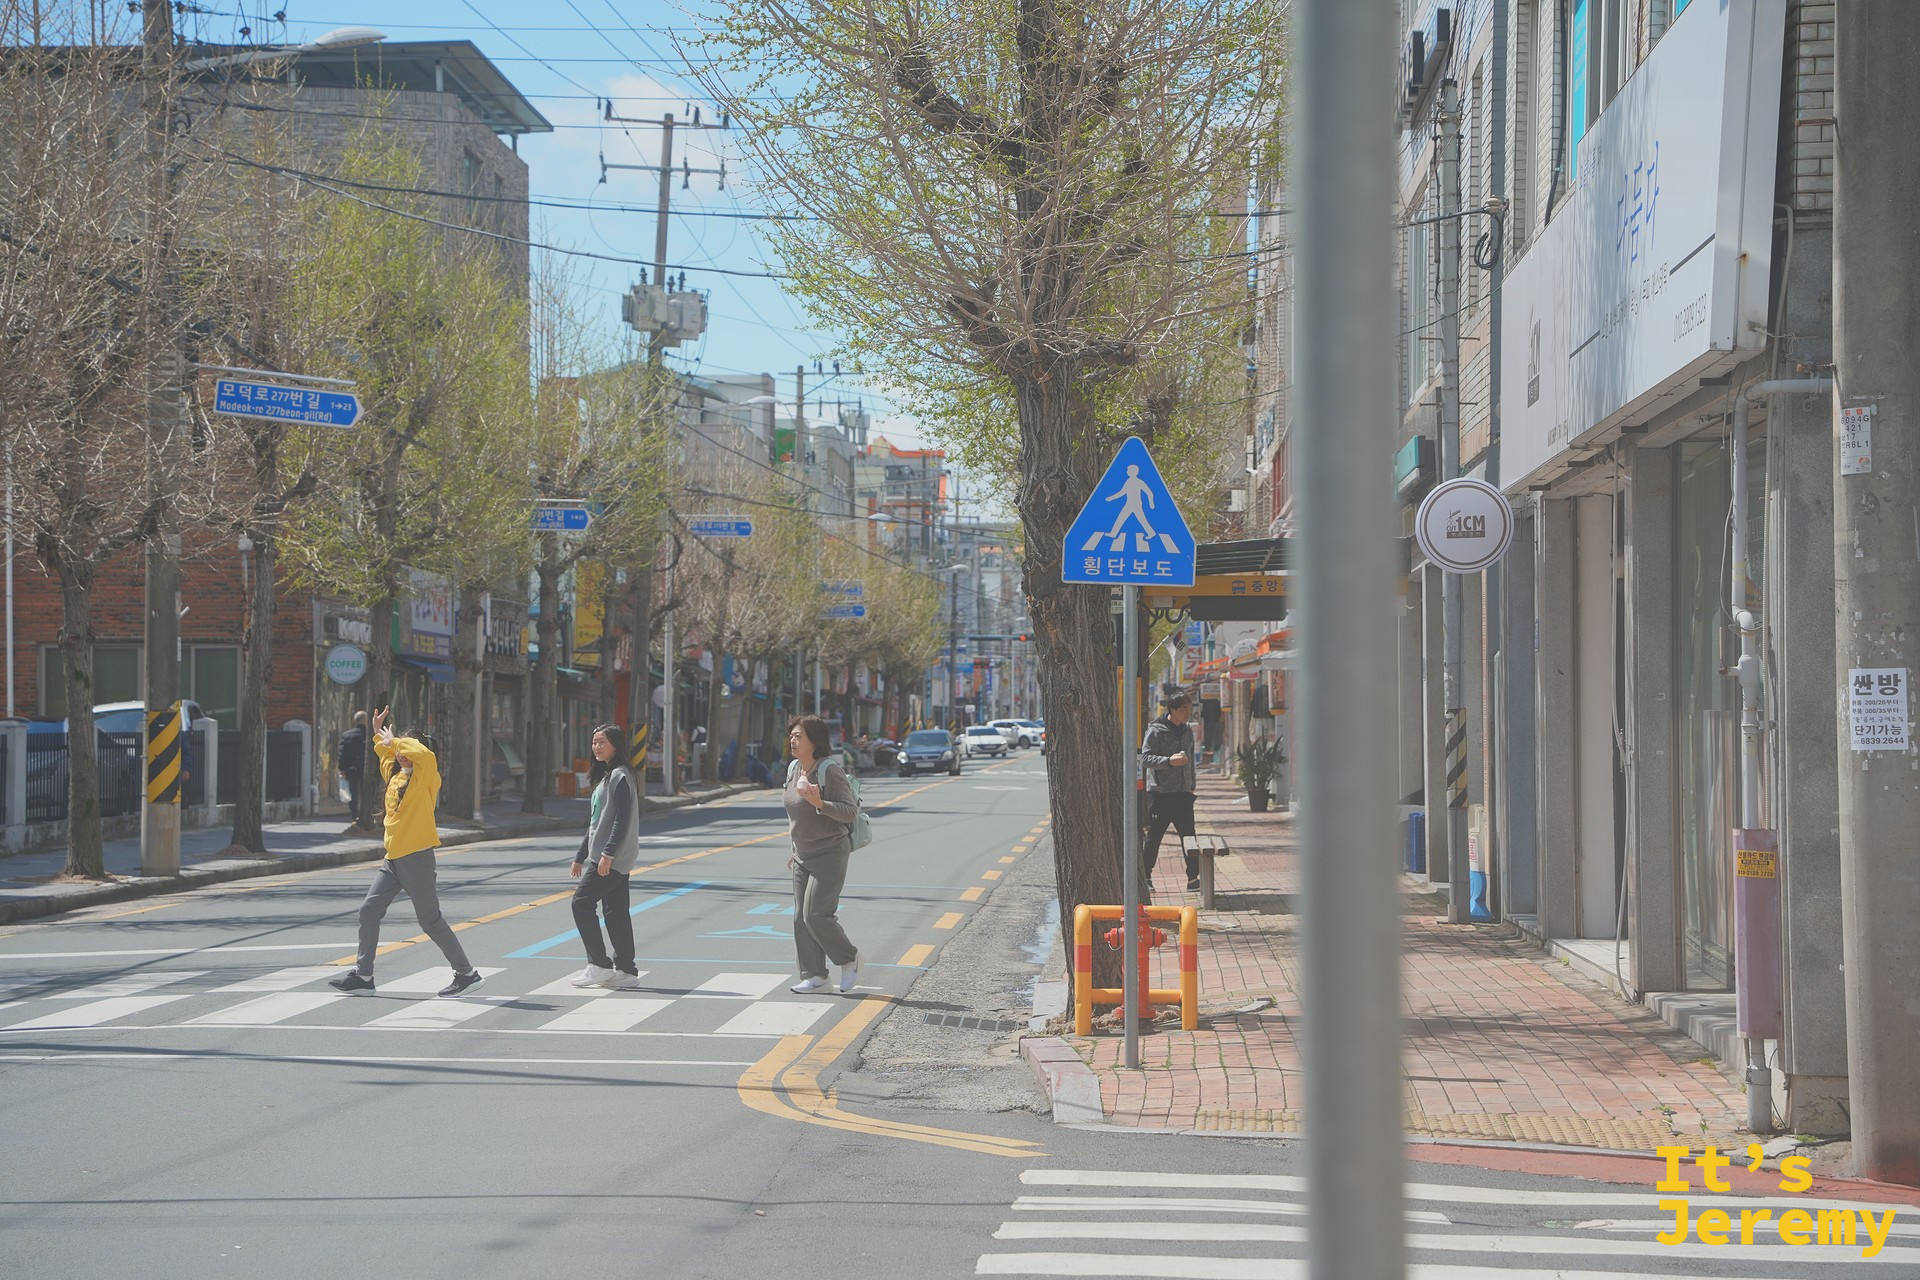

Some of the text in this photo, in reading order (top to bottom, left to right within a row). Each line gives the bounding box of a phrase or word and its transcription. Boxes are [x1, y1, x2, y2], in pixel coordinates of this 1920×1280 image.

[220, 383, 320, 410] 모덕로277번길
[219, 400, 264, 414] Modeok-ro
[1456, 515, 1485, 531] 1CM
[1083, 556, 1173, 577] 횡단보도
[329, 660, 362, 668] COFFEE
[1855, 725, 1902, 736] 단기가능
